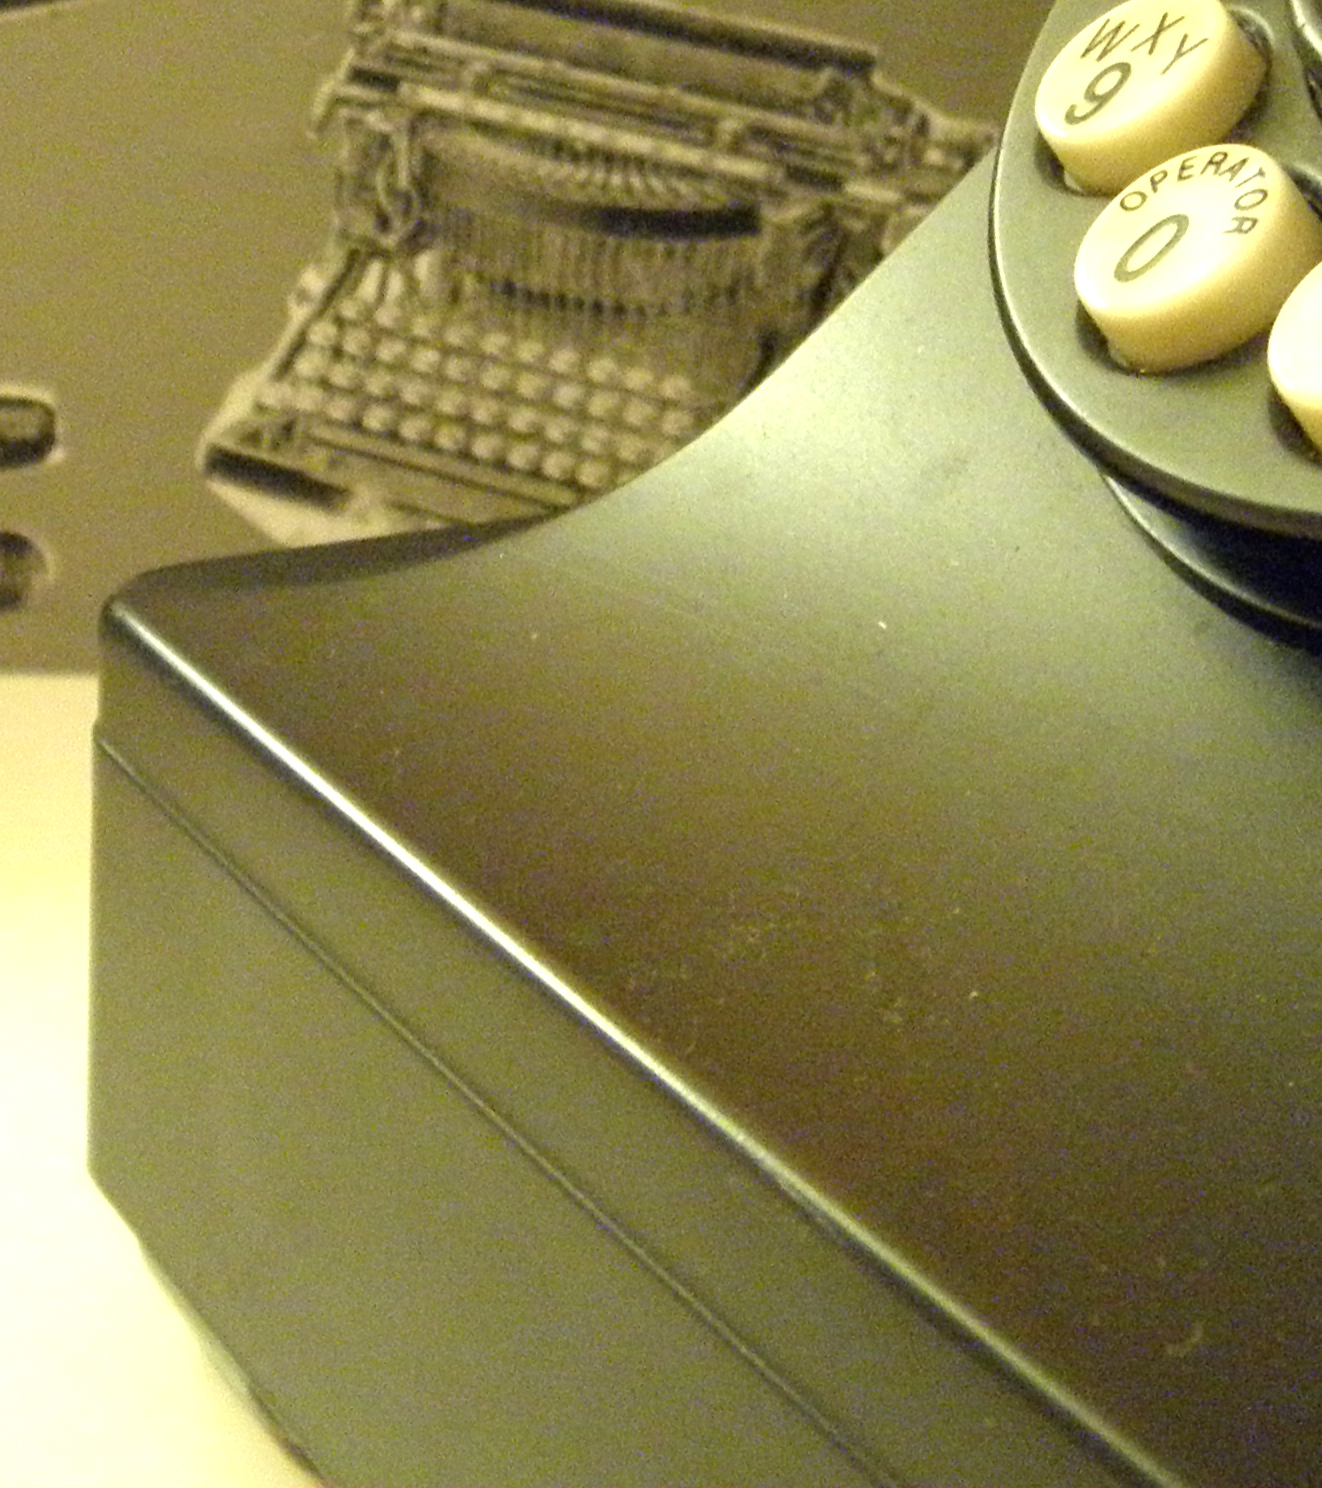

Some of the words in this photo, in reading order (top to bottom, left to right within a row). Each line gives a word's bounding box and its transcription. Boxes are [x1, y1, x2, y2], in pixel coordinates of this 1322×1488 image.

[1079, 11, 1209, 76] WXY
[1064, 61, 1132, 126] 9
[1119, 150, 1269, 236] OPERATOR
[1113, 212, 1190, 284] 0
